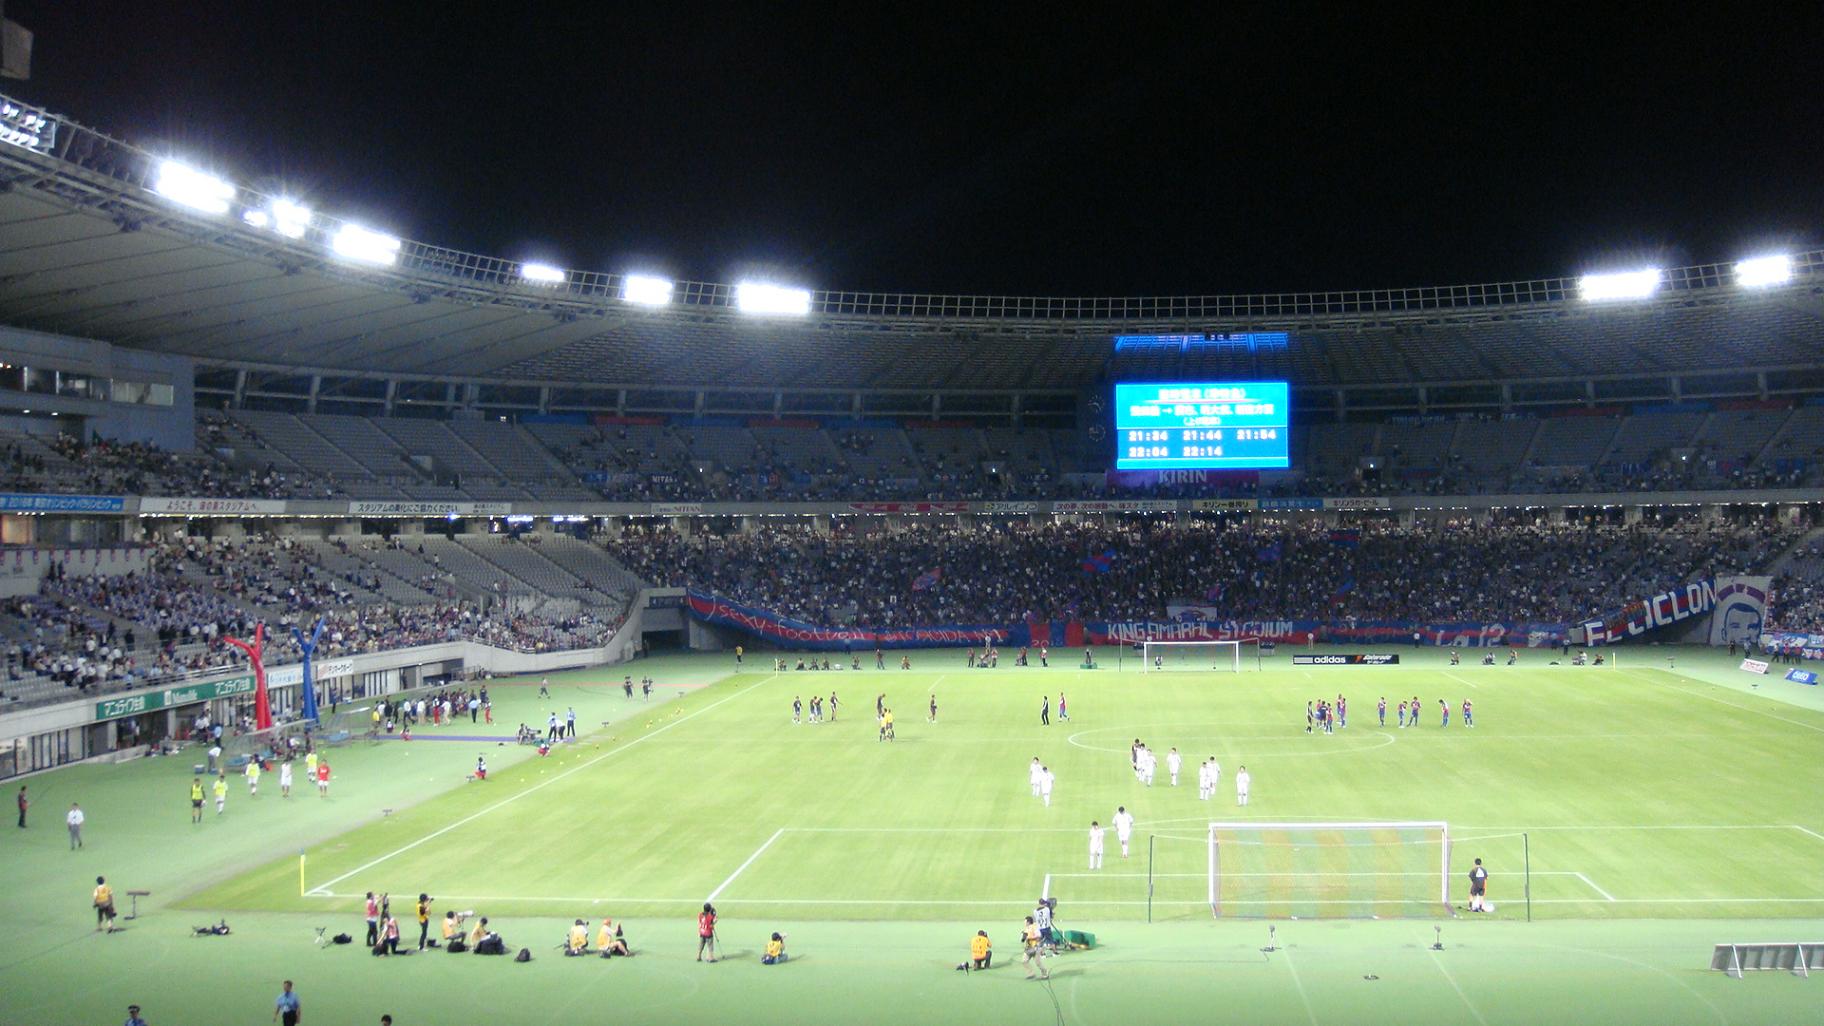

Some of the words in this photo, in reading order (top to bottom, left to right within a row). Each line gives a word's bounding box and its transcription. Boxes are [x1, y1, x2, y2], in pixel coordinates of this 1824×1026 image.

[1183, 430, 1222, 440] 21:44
[1183, 446, 1222, 456] 22:14
[1158, 471, 1208, 484] KIRIN
[1108, 622, 1146, 640] KING
[1314, 655, 1346, 664] adidas
